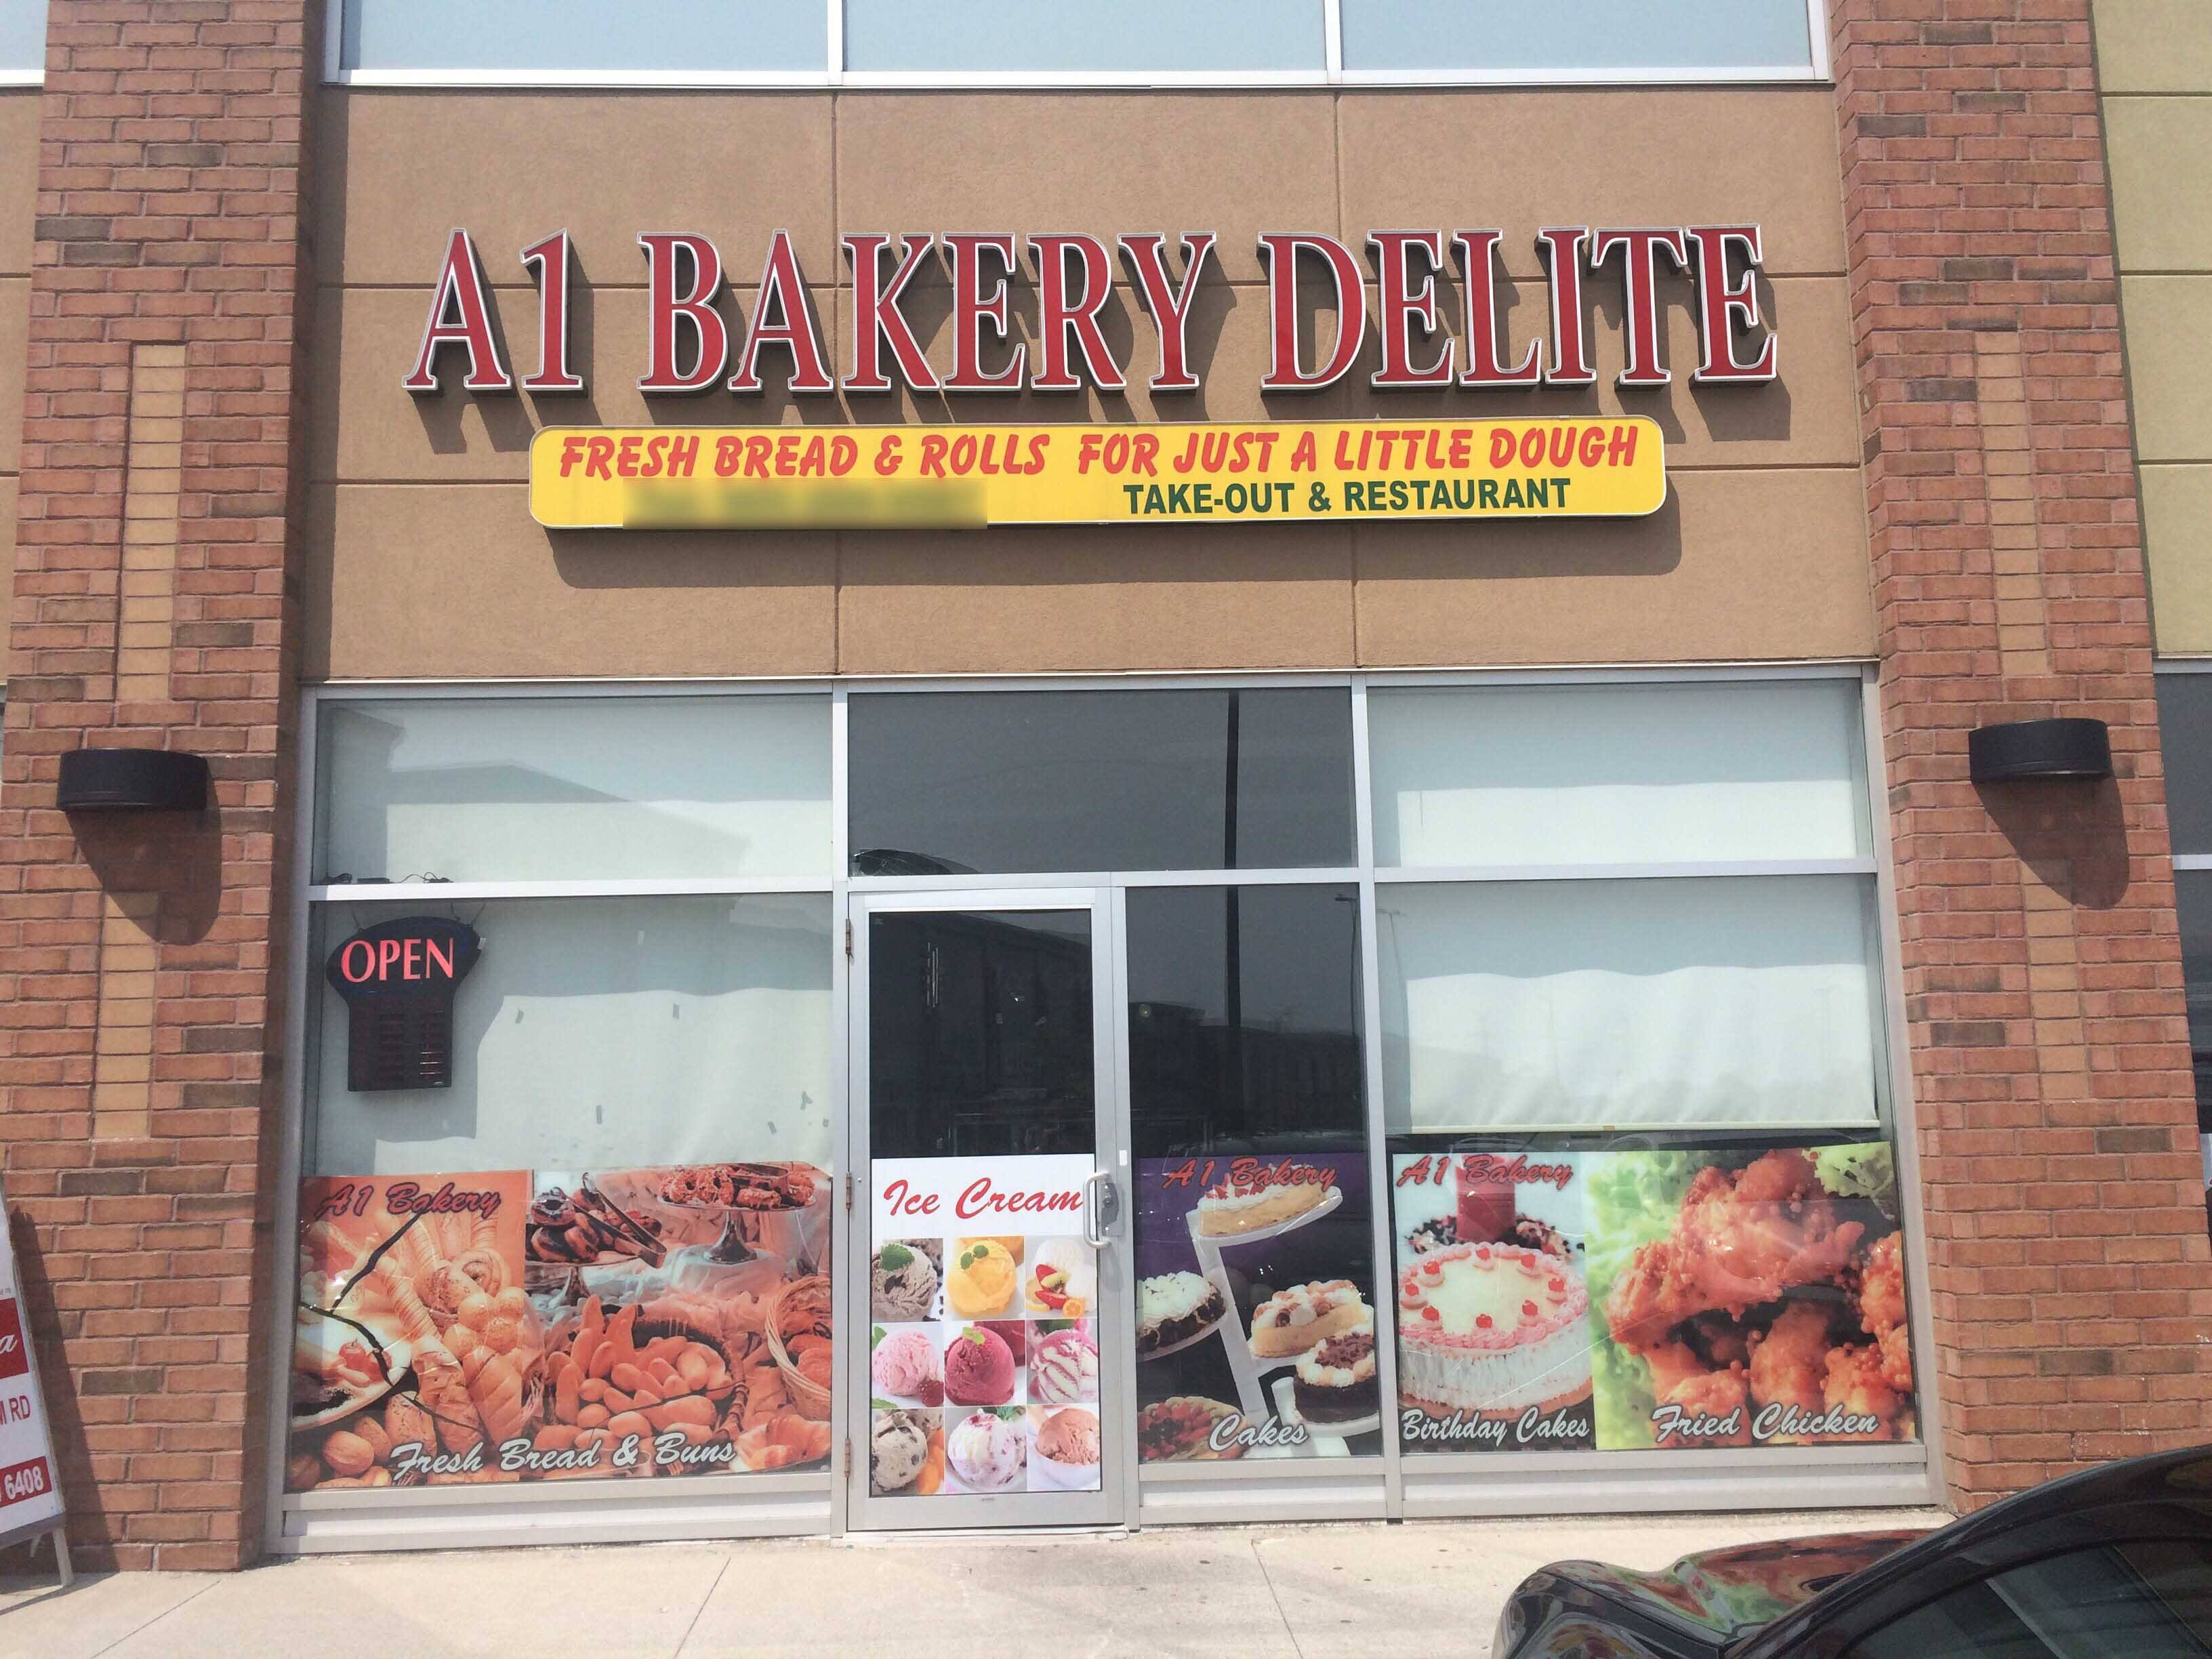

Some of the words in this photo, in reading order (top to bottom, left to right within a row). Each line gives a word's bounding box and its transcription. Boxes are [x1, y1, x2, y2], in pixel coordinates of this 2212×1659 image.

[401, 228, 583, 390] A1
[636, 228, 1216, 392] BAKERY
[1258, 224, 1777, 390] DELITE
[560, 436, 699, 480] FRESH
[714, 434, 857, 478] BREAD
[874, 434, 903, 474] &
[920, 433, 1050, 478] ROLLS
[1078, 432, 1160, 477] FOR
[1173, 431, 1279, 474] JUST
[1290, 431, 1317, 472] A
[1334, 429, 1473, 471] LITTLE
[1489, 426, 1639, 468] DOUGH
[1123, 482, 1295, 514] TAKE-OUT
[1308, 480, 1332, 512] &
[1344, 477, 1571, 512] RESTAURANT
[341, 937, 454, 983] OPEN
[1162, 1158, 1215, 1189] A1
[1229, 1156, 1337, 1192] Bakery
[1397, 1155, 1452, 1187] A1
[1464, 1153, 1573, 1191] Bakery
[314, 1183, 374, 1217] A1
[386, 1182, 502, 1218] Bakery
[883, 1179, 941, 1216] Ice
[955, 1177, 1084, 1219] Cream
[8, 1395, 31, 1422] RD
[1401, 1408, 1507, 1447] Birthday
[1516, 1406, 1590, 1443] Cakes
[1652, 1404, 1741, 1443] Fried
[1751, 1402, 1879, 1440] Chicken
[1208, 1413, 1309, 1452] Cakes
[390, 1440, 484, 1481] Fresh
[499, 1437, 602, 1471] Bread
[612, 1433, 640, 1467] &
[654, 1431, 737, 1465] Buns
[4, 1465, 44, 1500] 6408
